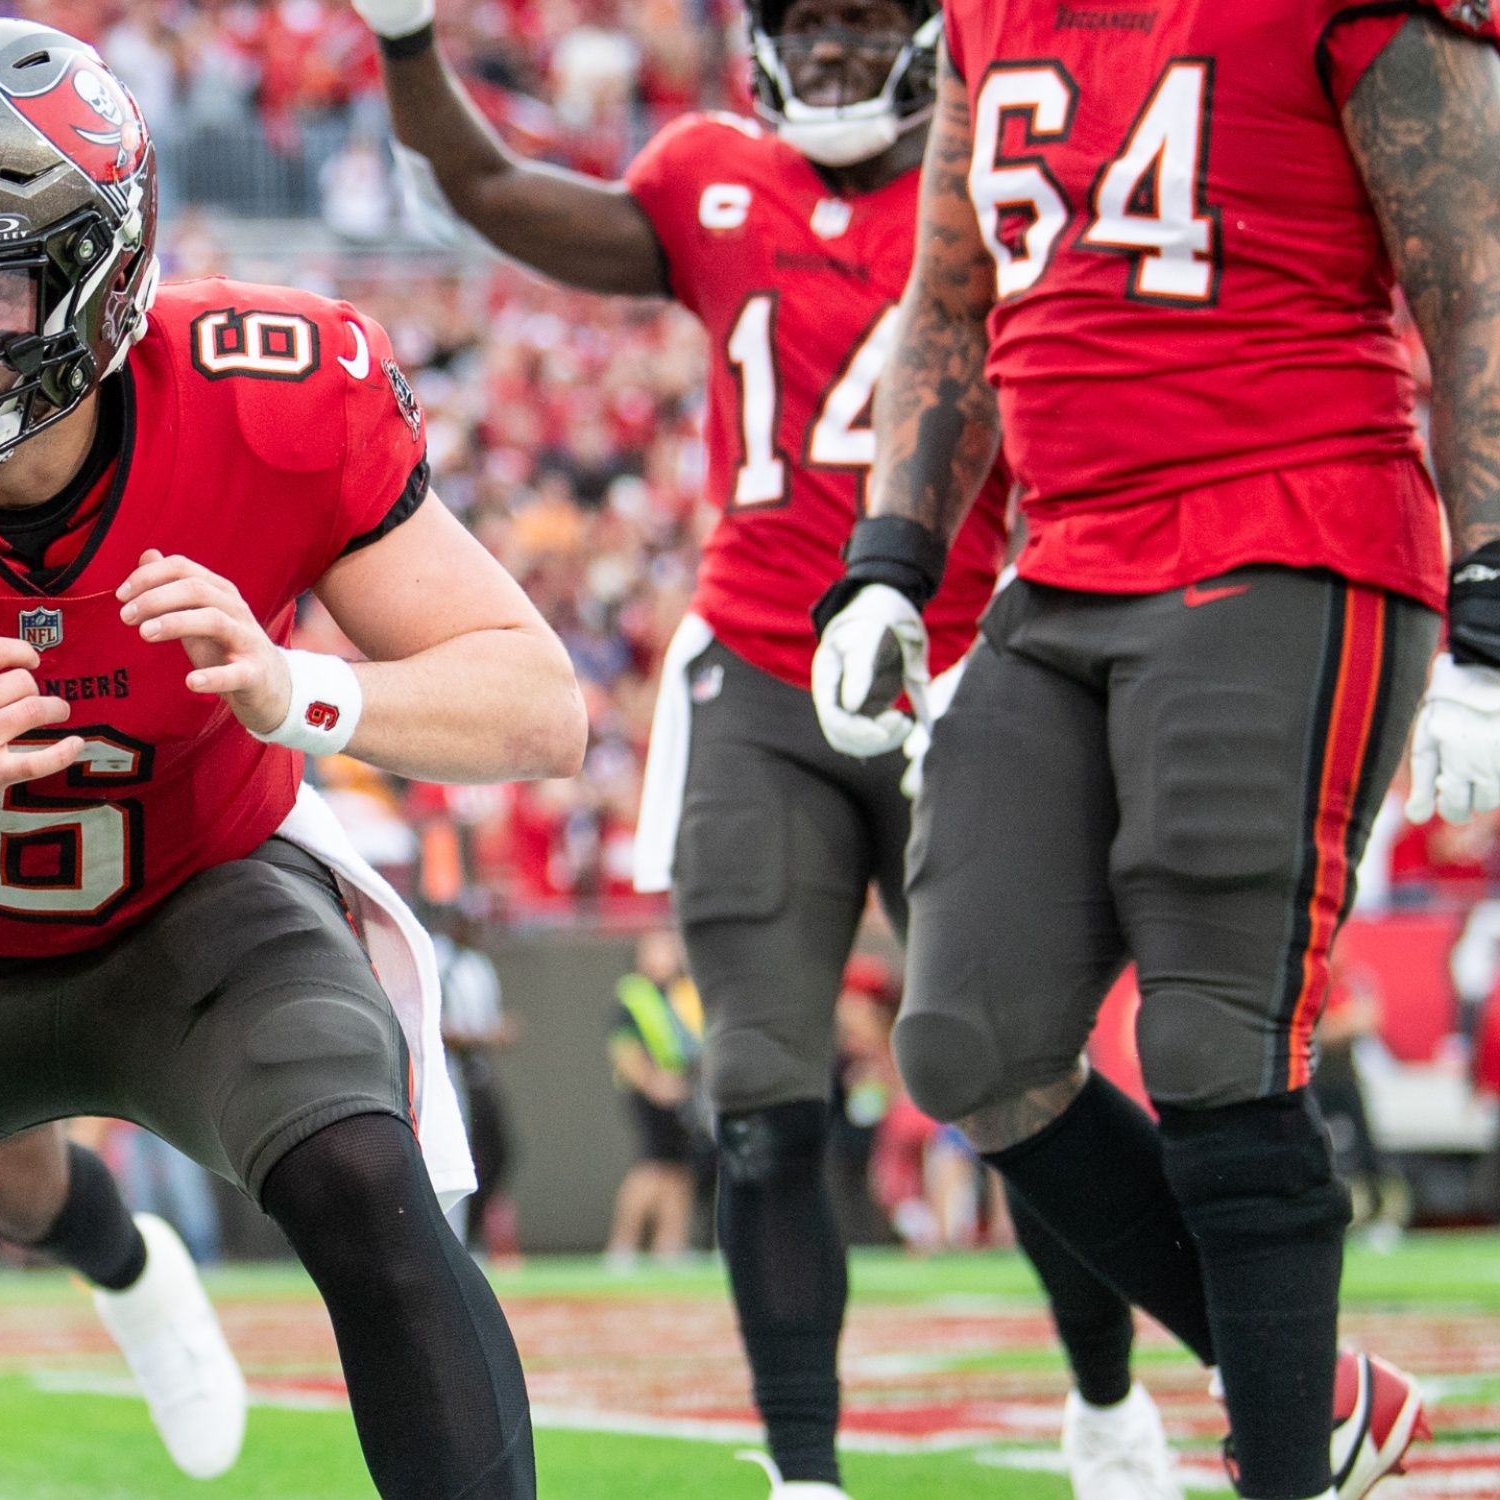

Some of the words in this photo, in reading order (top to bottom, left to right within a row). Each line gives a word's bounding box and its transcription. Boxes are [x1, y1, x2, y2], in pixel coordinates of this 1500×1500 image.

[698, 183, 752, 229] C
[967, 57, 1222, 306] 64
[190, 307, 320, 382] 6
[725, 289, 901, 518] 14
[26, 628, 56, 644] NFL
[40, 668, 129, 701] NEERS
